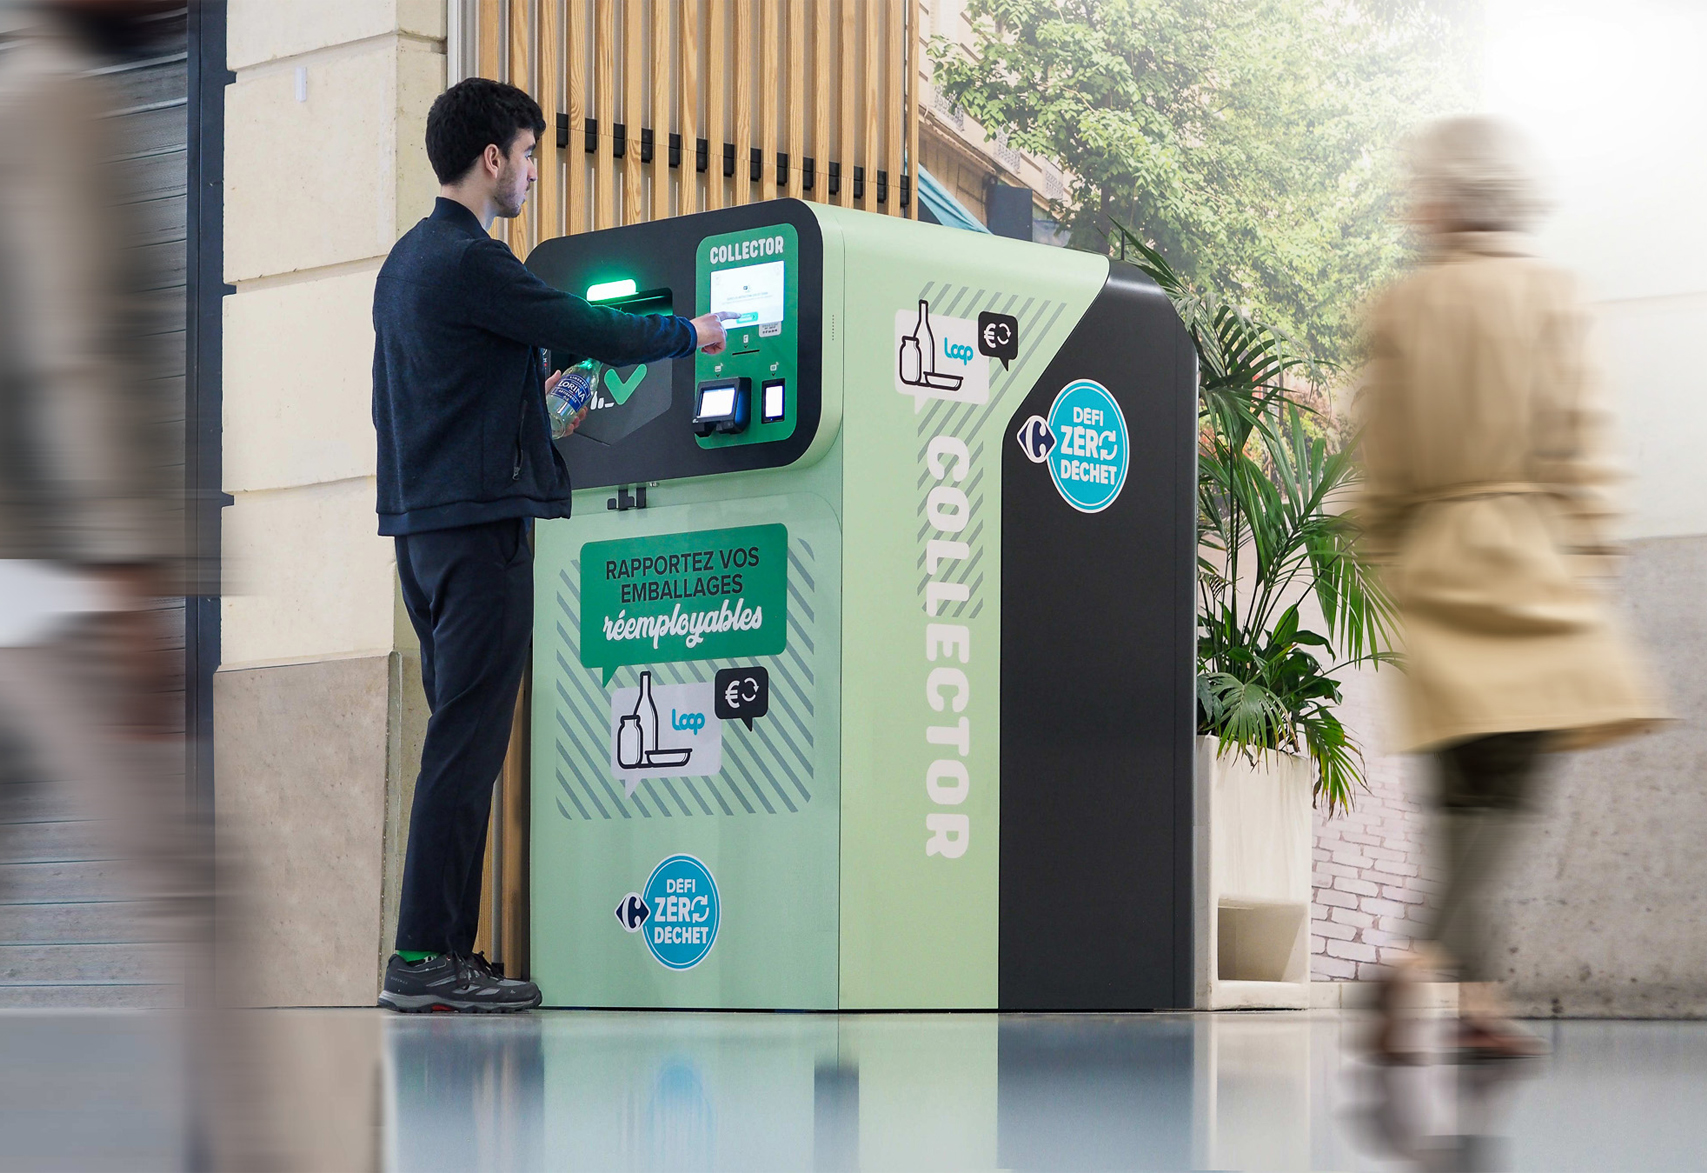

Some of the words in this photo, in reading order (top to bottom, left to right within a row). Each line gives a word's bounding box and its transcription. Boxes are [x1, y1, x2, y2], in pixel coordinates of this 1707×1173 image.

[709, 235, 784, 265] COLLECTOR
[557, 380, 586, 403] LORINA
[606, 550, 714, 580] RAPPORTEZ
[719, 546, 760, 568] VOS
[620, 573, 743, 604] EMBALLAGES
[602, 597, 763, 650] réemployables
[926, 435, 970, 859] COLLECTOR
